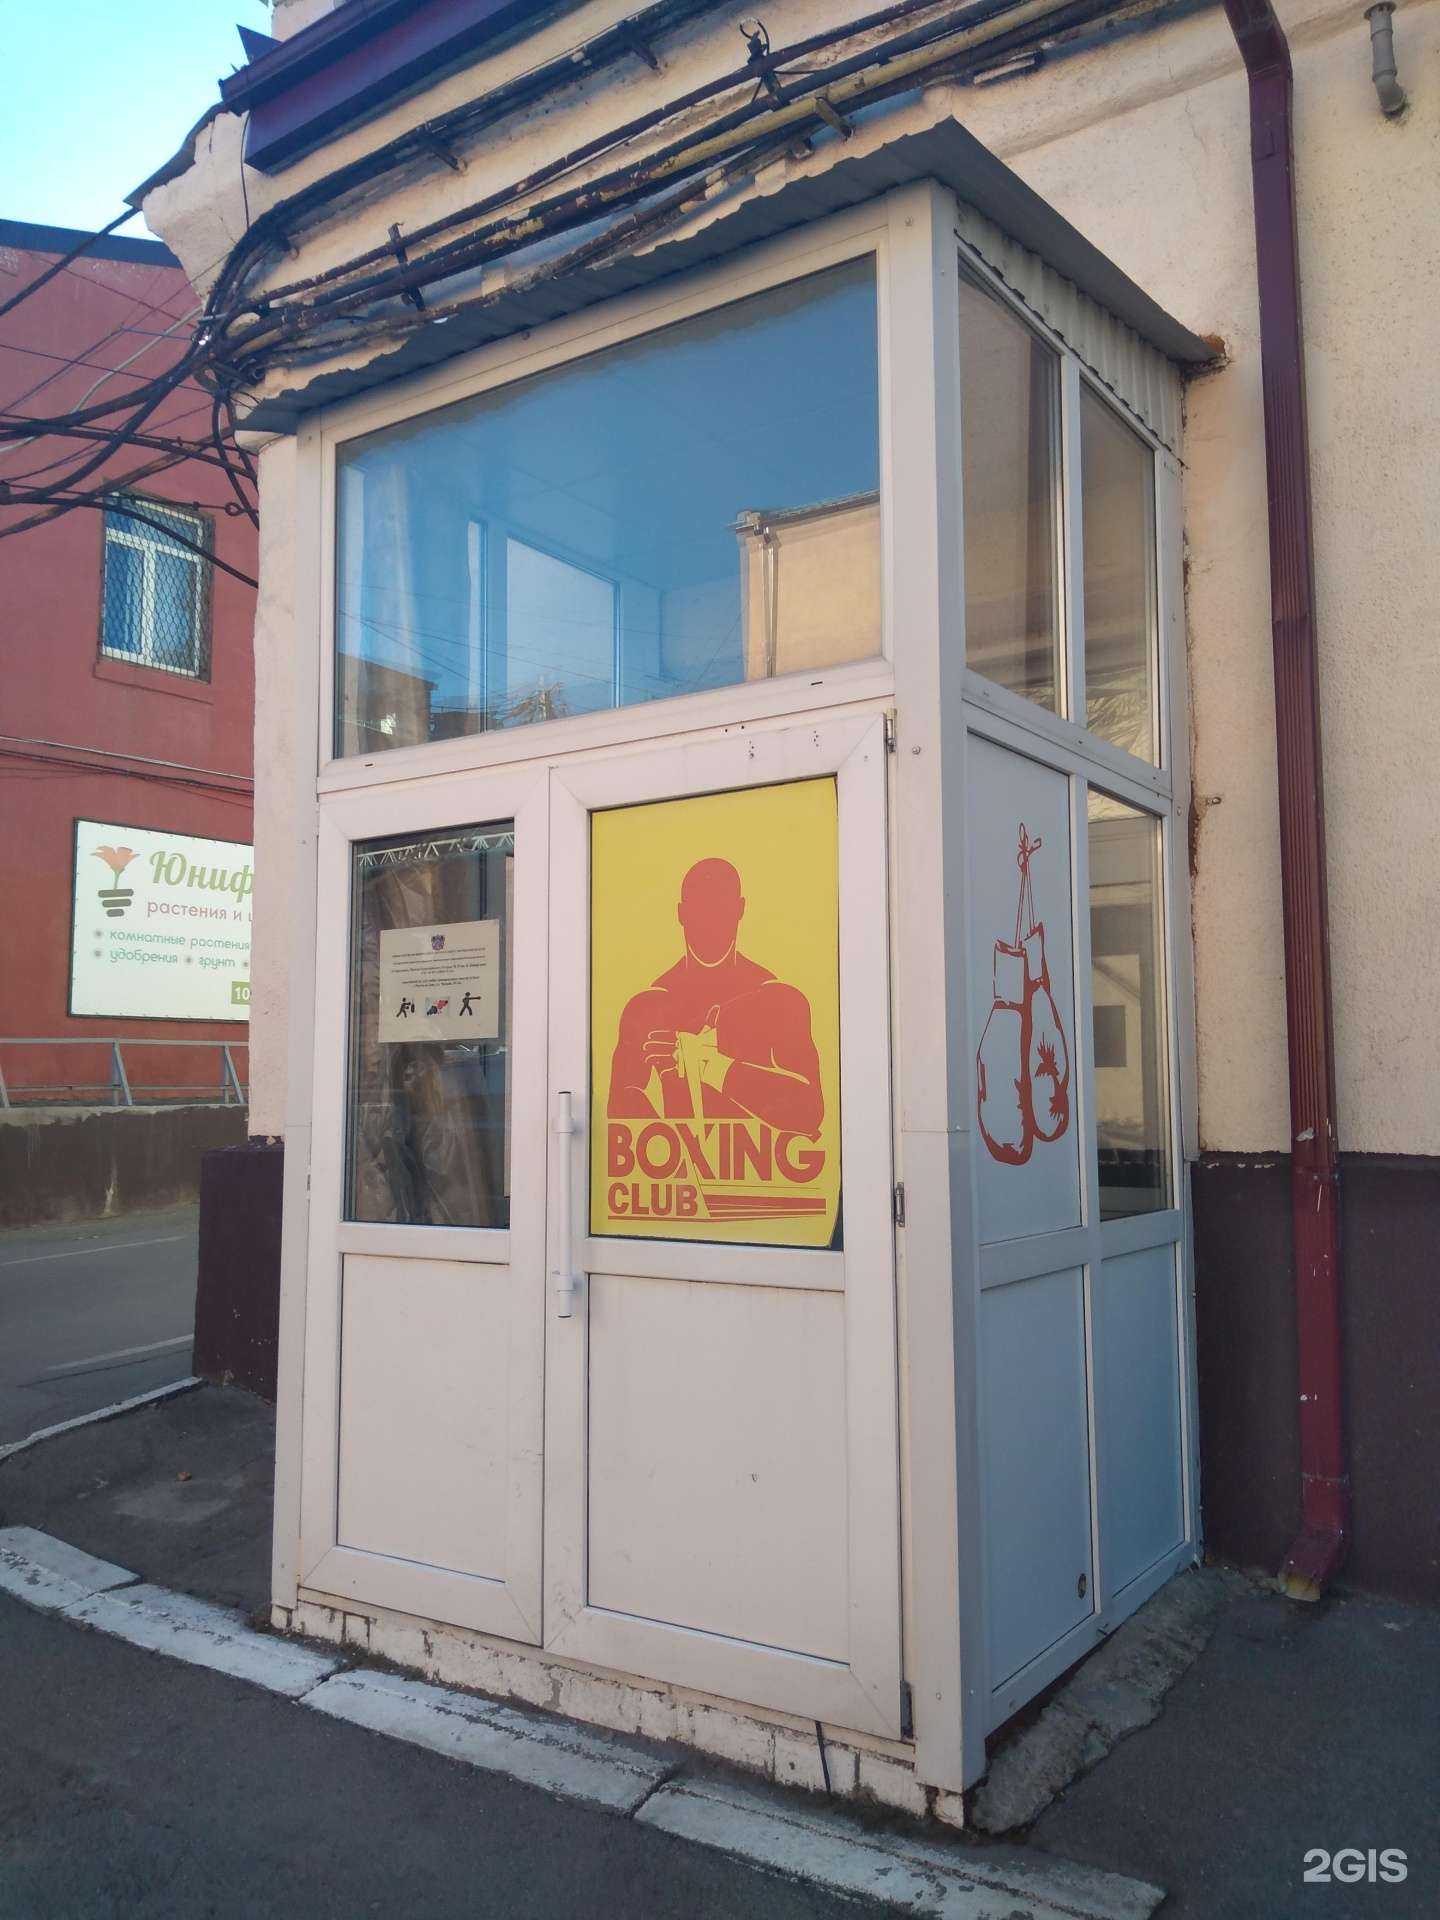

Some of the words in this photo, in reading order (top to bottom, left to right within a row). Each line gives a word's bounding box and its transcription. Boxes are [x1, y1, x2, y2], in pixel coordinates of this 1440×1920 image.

[147, 900, 227, 920] растения
[233, 910, 242, 921] и
[110, 930, 186, 946] комнатные
[110, 949, 178, 965] удобрения
[607, 1121, 826, 1183] BOXING
[607, 1182, 698, 1217] CLUB
